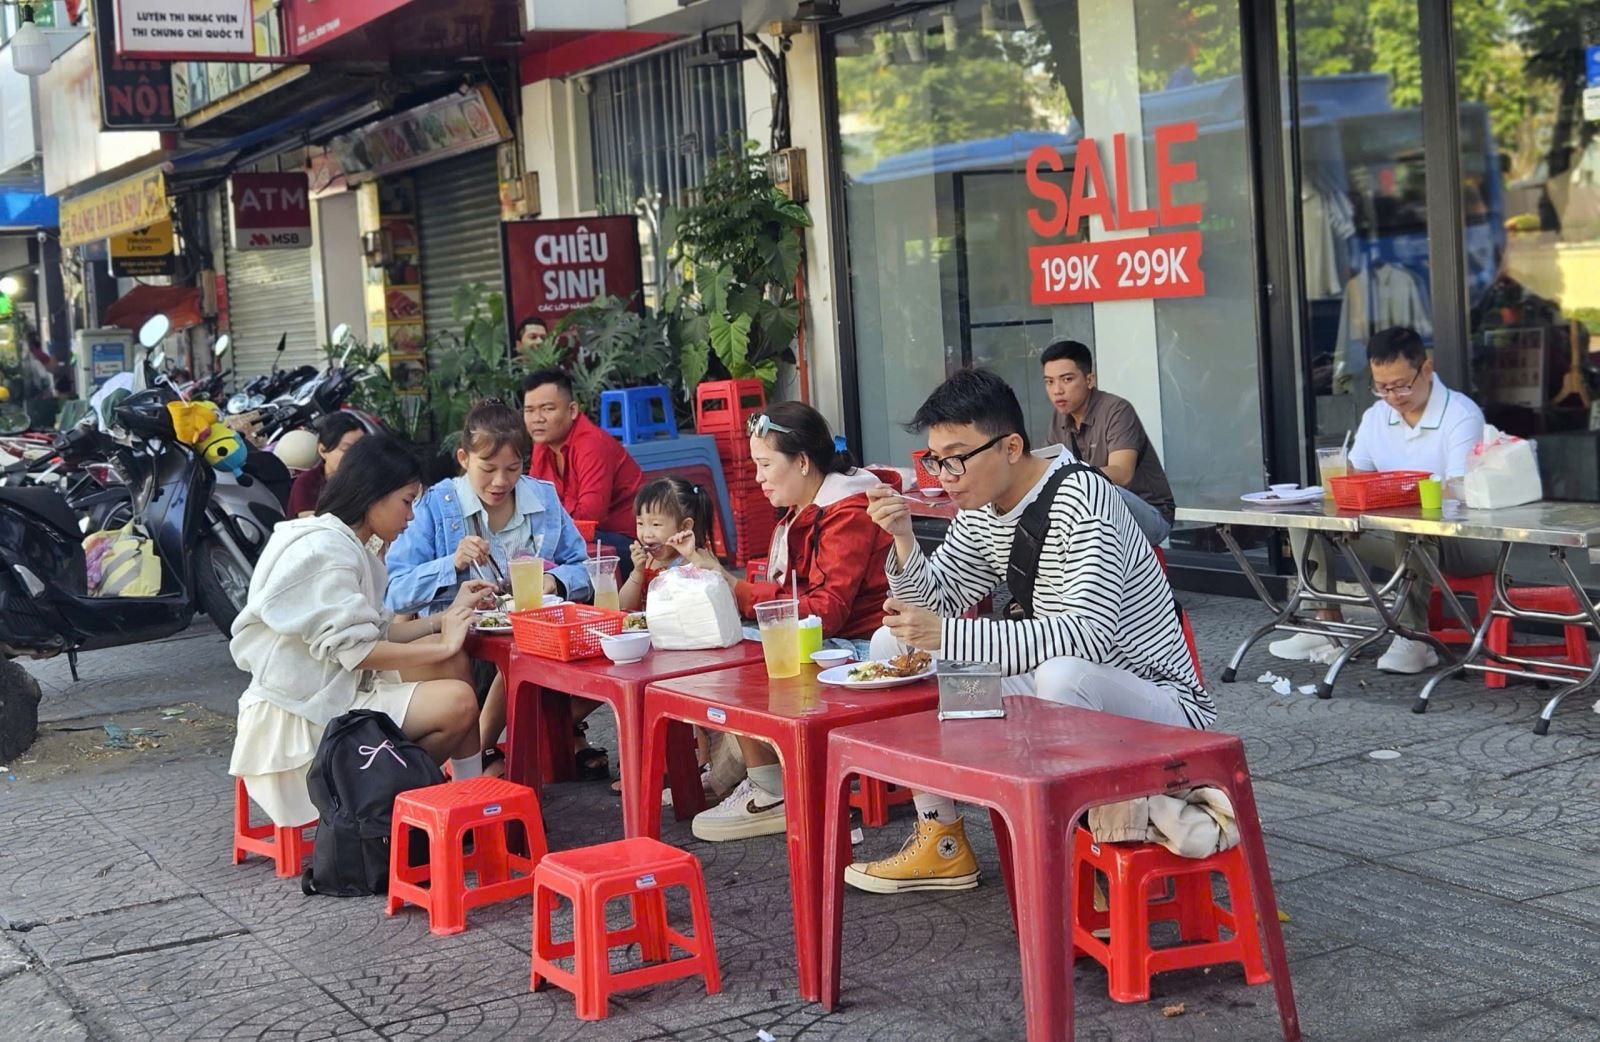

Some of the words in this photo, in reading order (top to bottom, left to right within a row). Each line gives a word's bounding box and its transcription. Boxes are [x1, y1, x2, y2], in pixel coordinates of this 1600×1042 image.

[169, 13, 185, 22] THI
[132, 28, 148, 37] THI
[108, 73, 171, 122] NỘI
[1026, 120, 1202, 237] SALE
[239, 187, 305, 211] ATM
[271, 233, 300, 244] MSB
[534, 226, 608, 265] CHIÊU
[1041, 254, 1101, 292] 199K
[1116, 246, 1190, 288] 299K
[543, 268, 606, 300] SINH
[538, 302, 553, 312] CÁC
